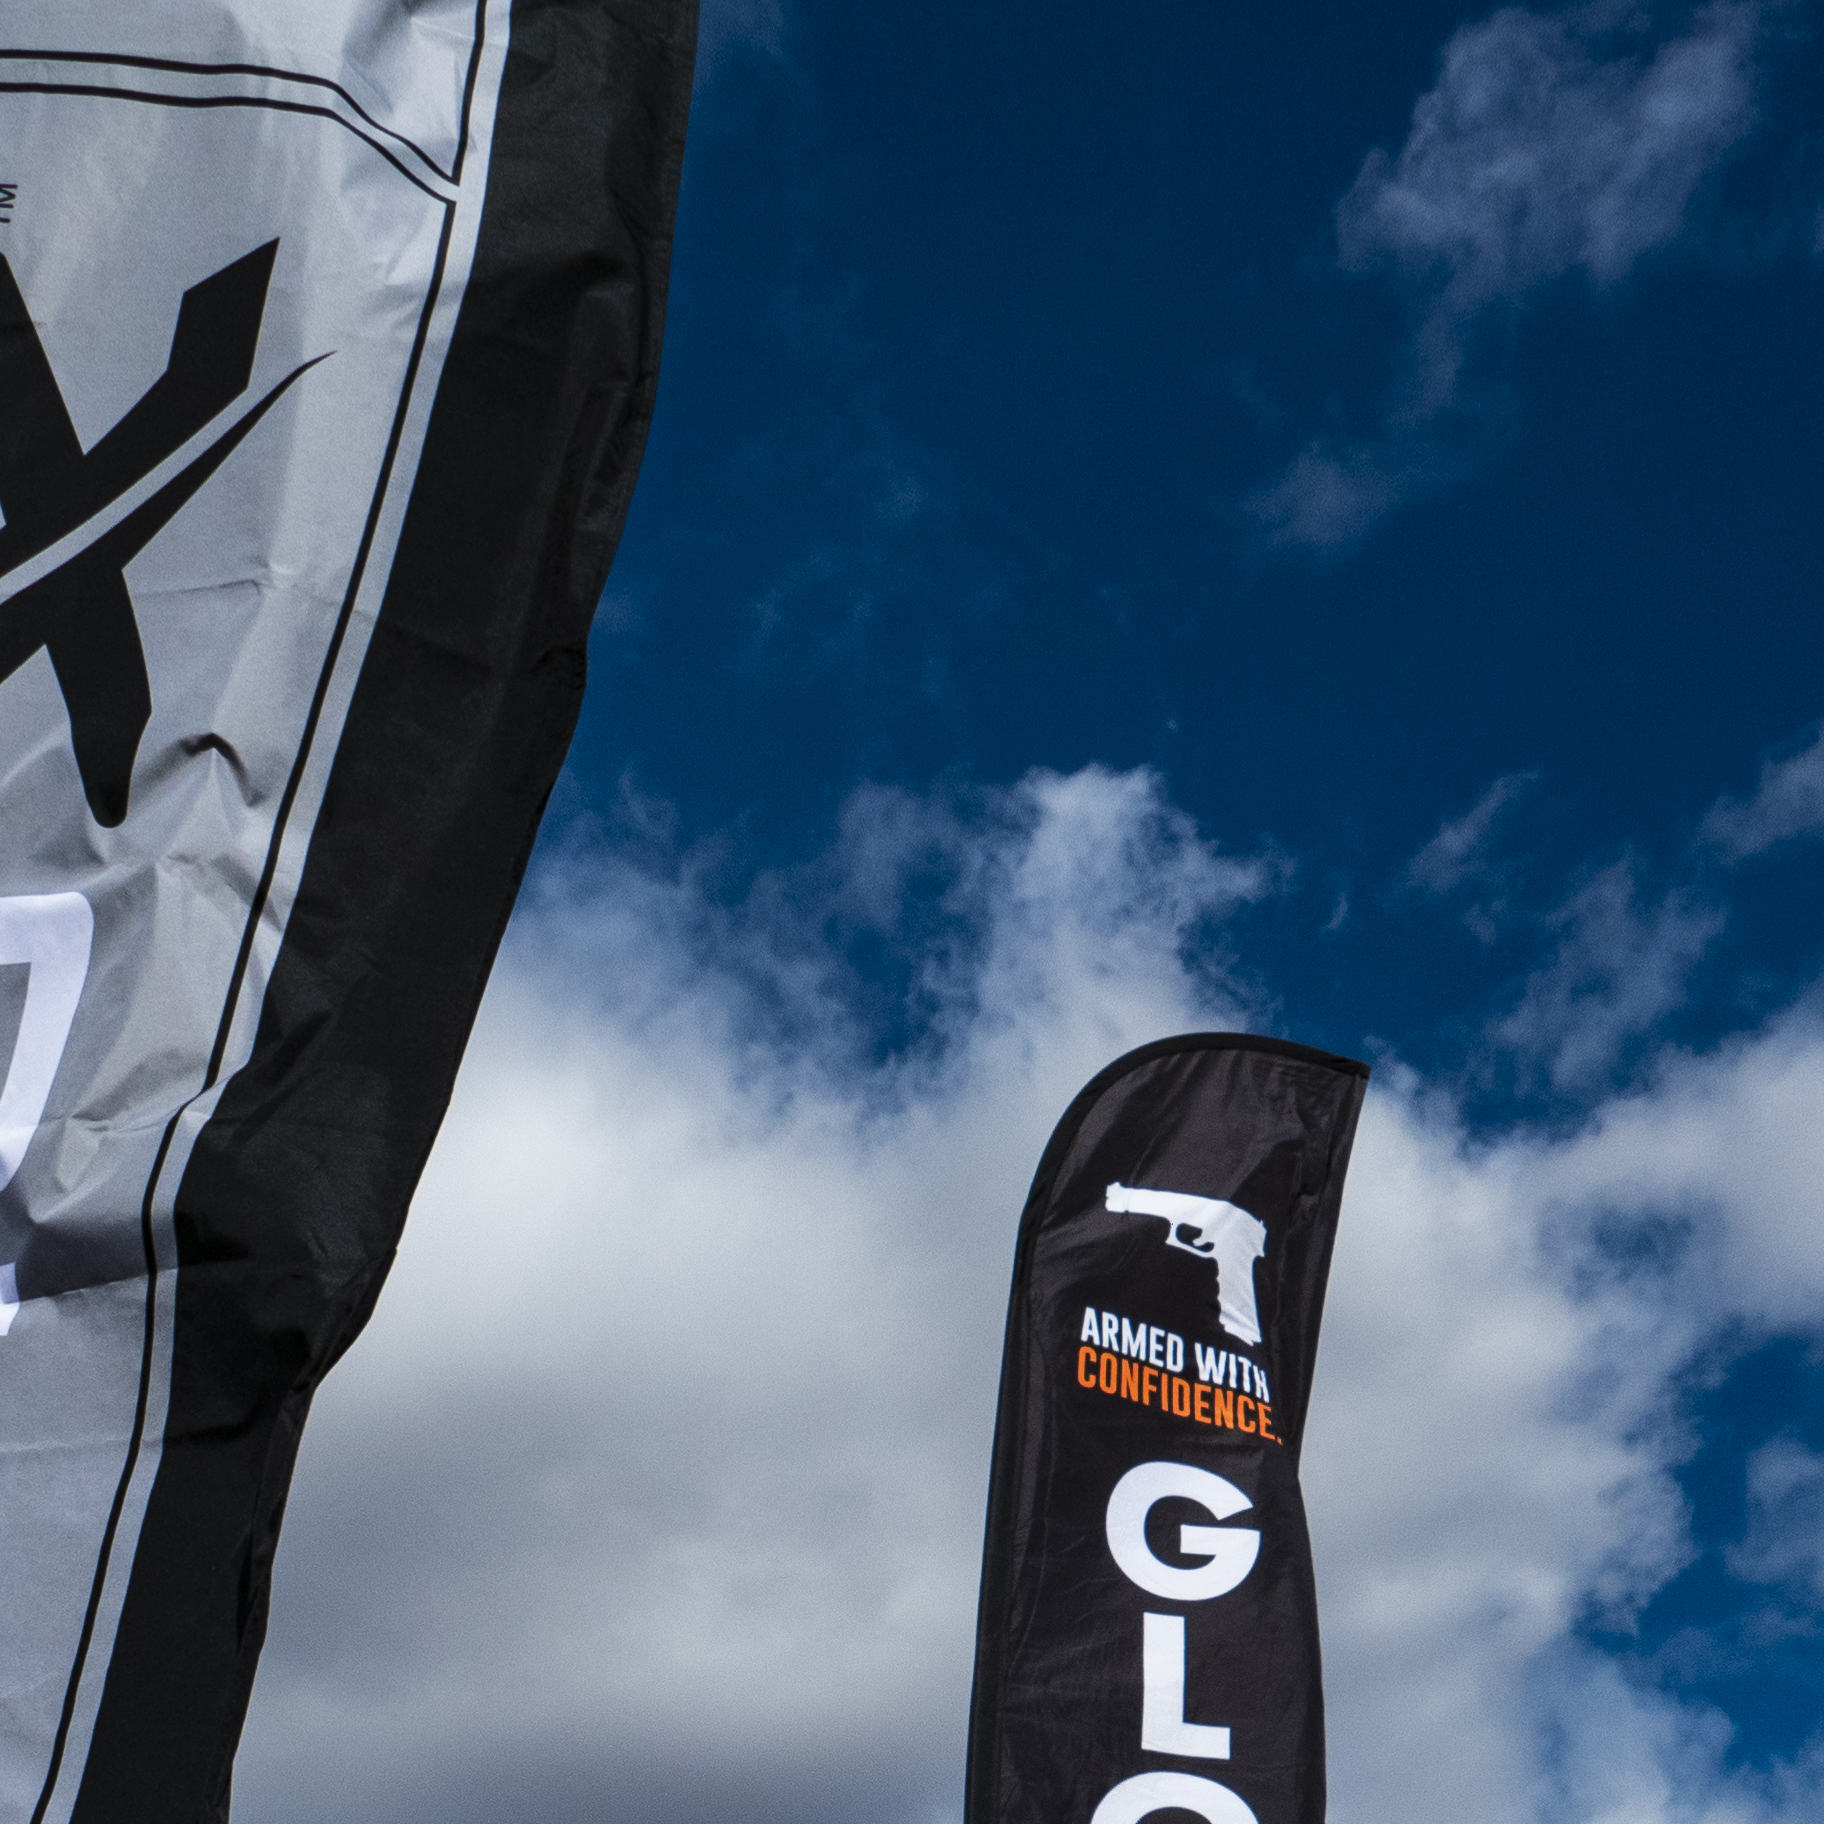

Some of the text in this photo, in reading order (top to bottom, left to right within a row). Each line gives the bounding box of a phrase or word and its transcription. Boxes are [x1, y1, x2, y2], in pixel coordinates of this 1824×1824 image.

[1077, 1346, 1284, 1446] CONFIDENCE.
[1081, 1306, 1271, 1403] ARMED WITH
